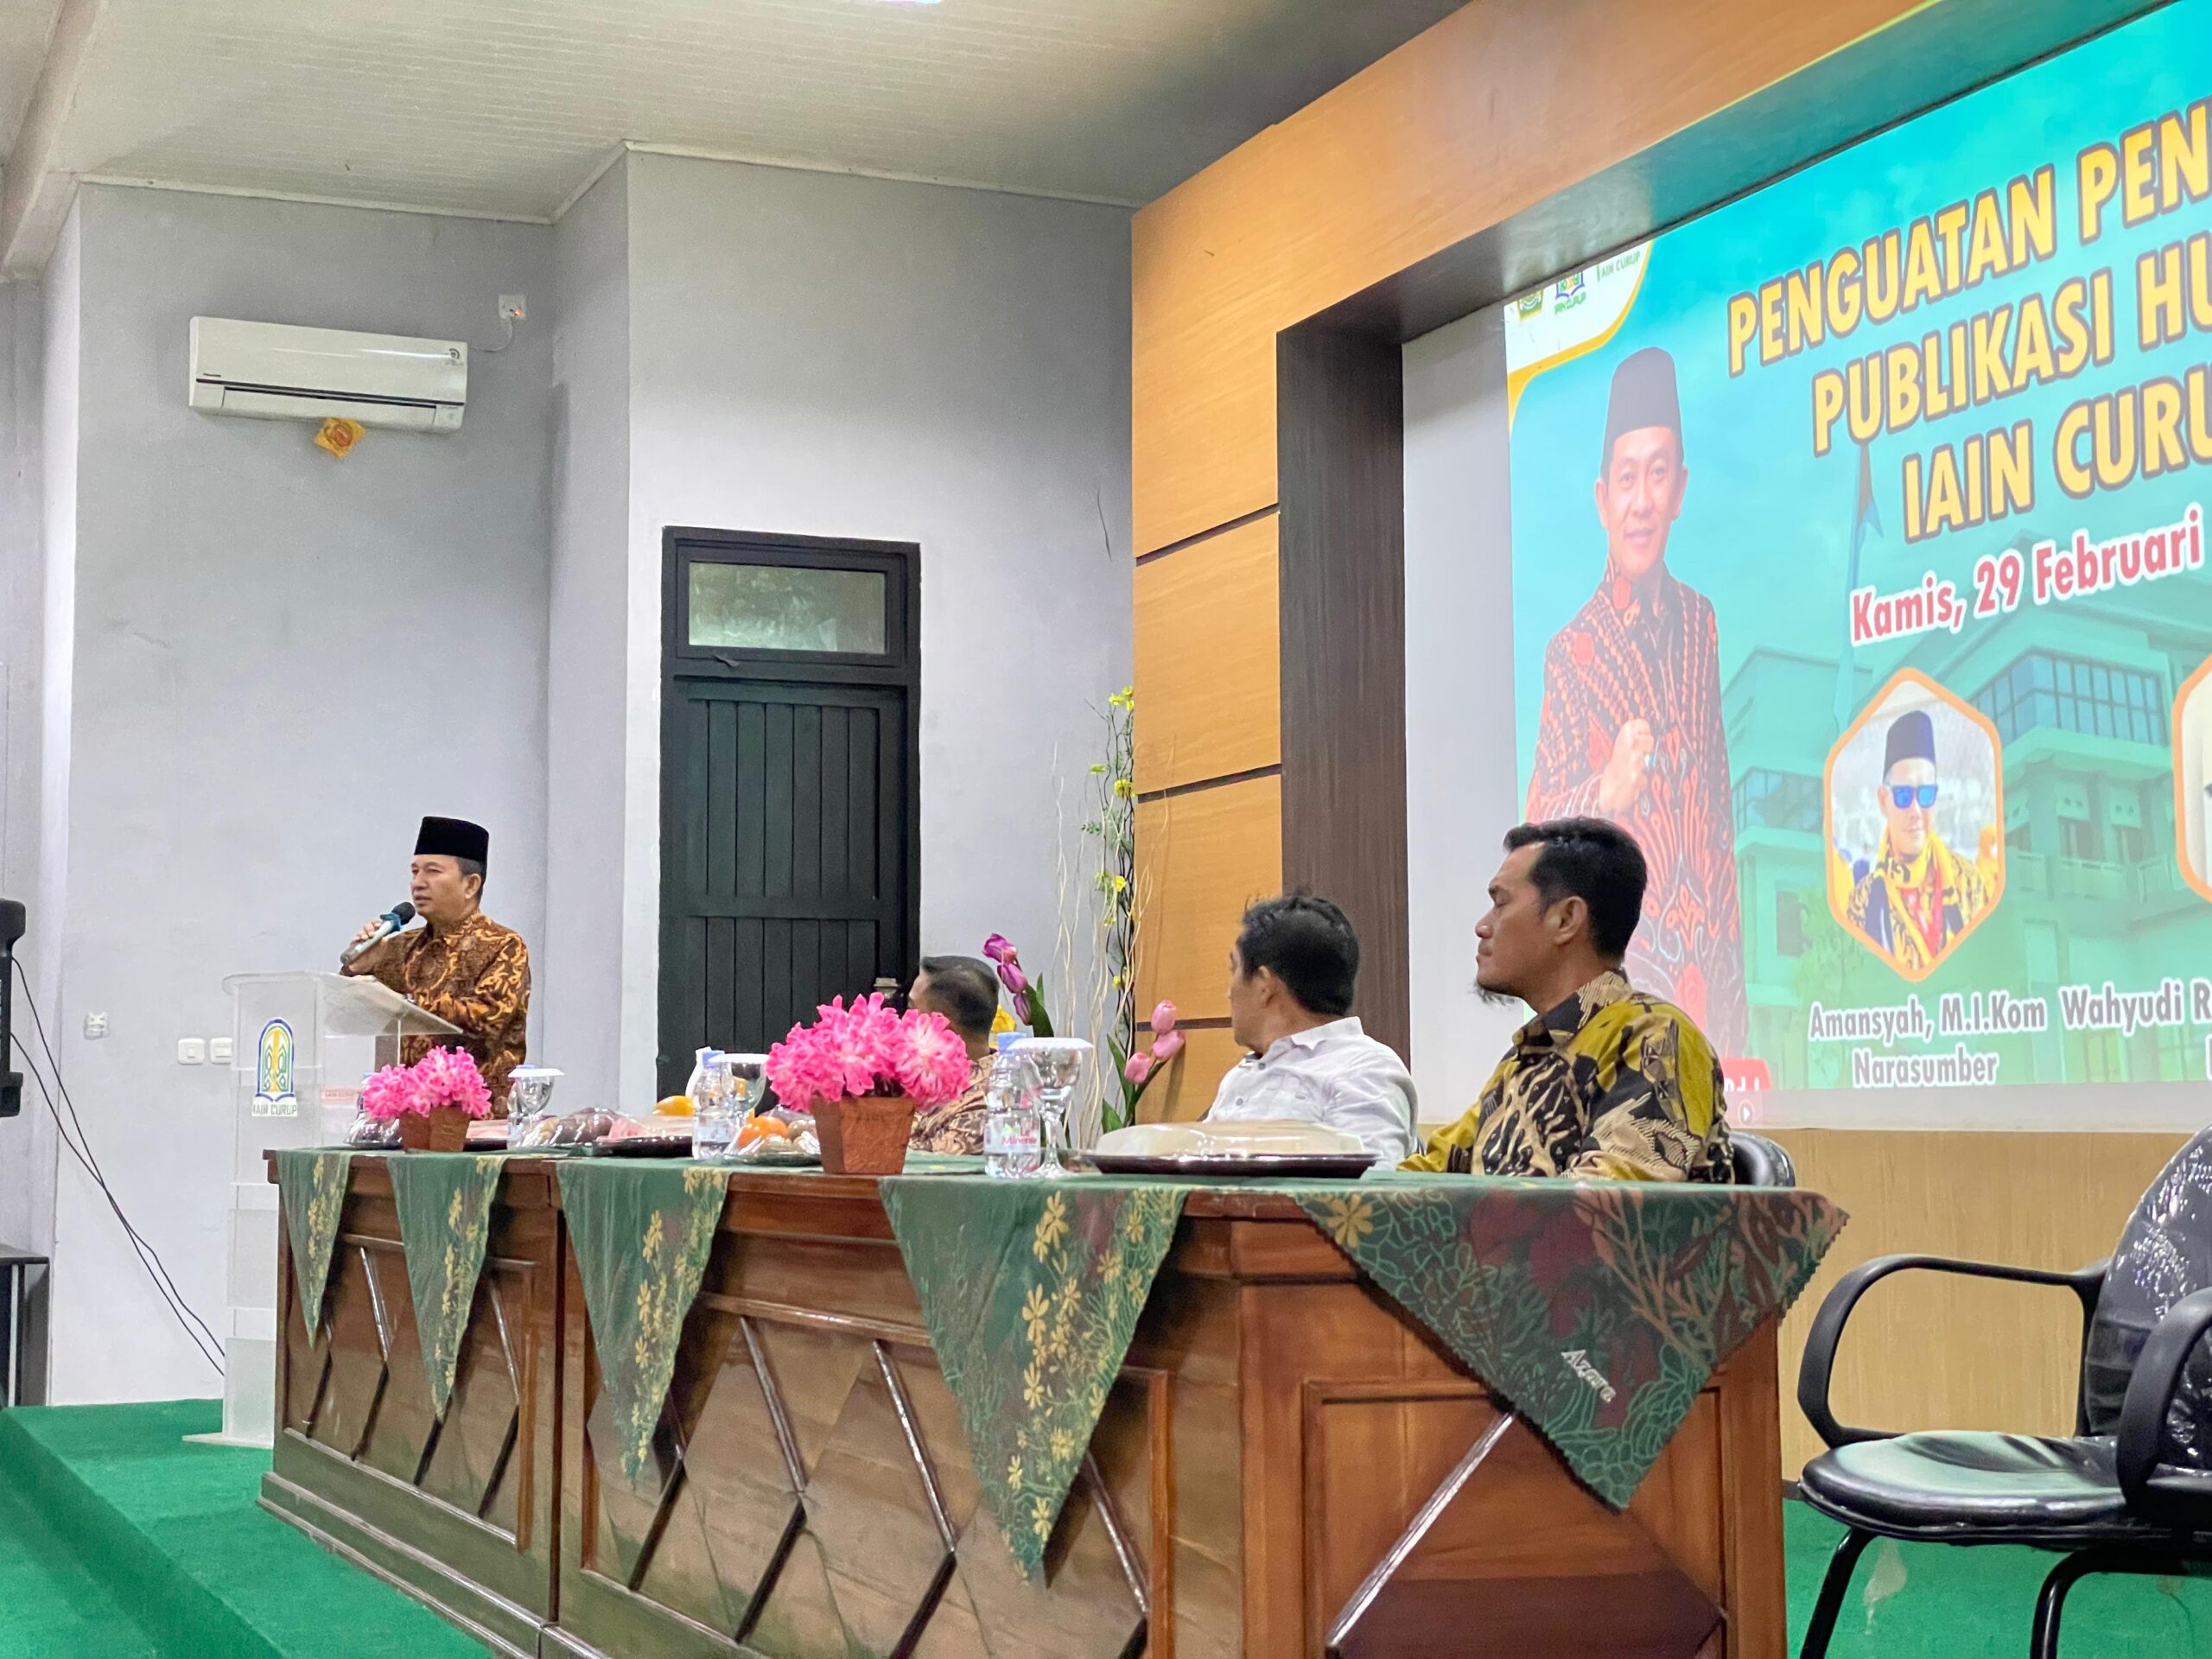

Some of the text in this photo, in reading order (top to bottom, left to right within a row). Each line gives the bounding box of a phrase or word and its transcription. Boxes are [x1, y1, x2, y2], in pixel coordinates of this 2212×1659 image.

[1729, 164, 2055, 377] PENGUATAN
[1814, 266, 2113, 456] PUBLIKASI
[1903, 419, 2034, 543] IAIN
[1853, 508, 2200, 642] Kamis, 29 Februari
[1810, 998, 1932, 1044] Amansyah,
[1942, 994, 2045, 1032] M.I.Kom
[2062, 982, 2181, 1033] Wahyudi
[1854, 1046, 1997, 1084] Narasumber
[252, 1104, 297, 1116] IAIN CURUP
